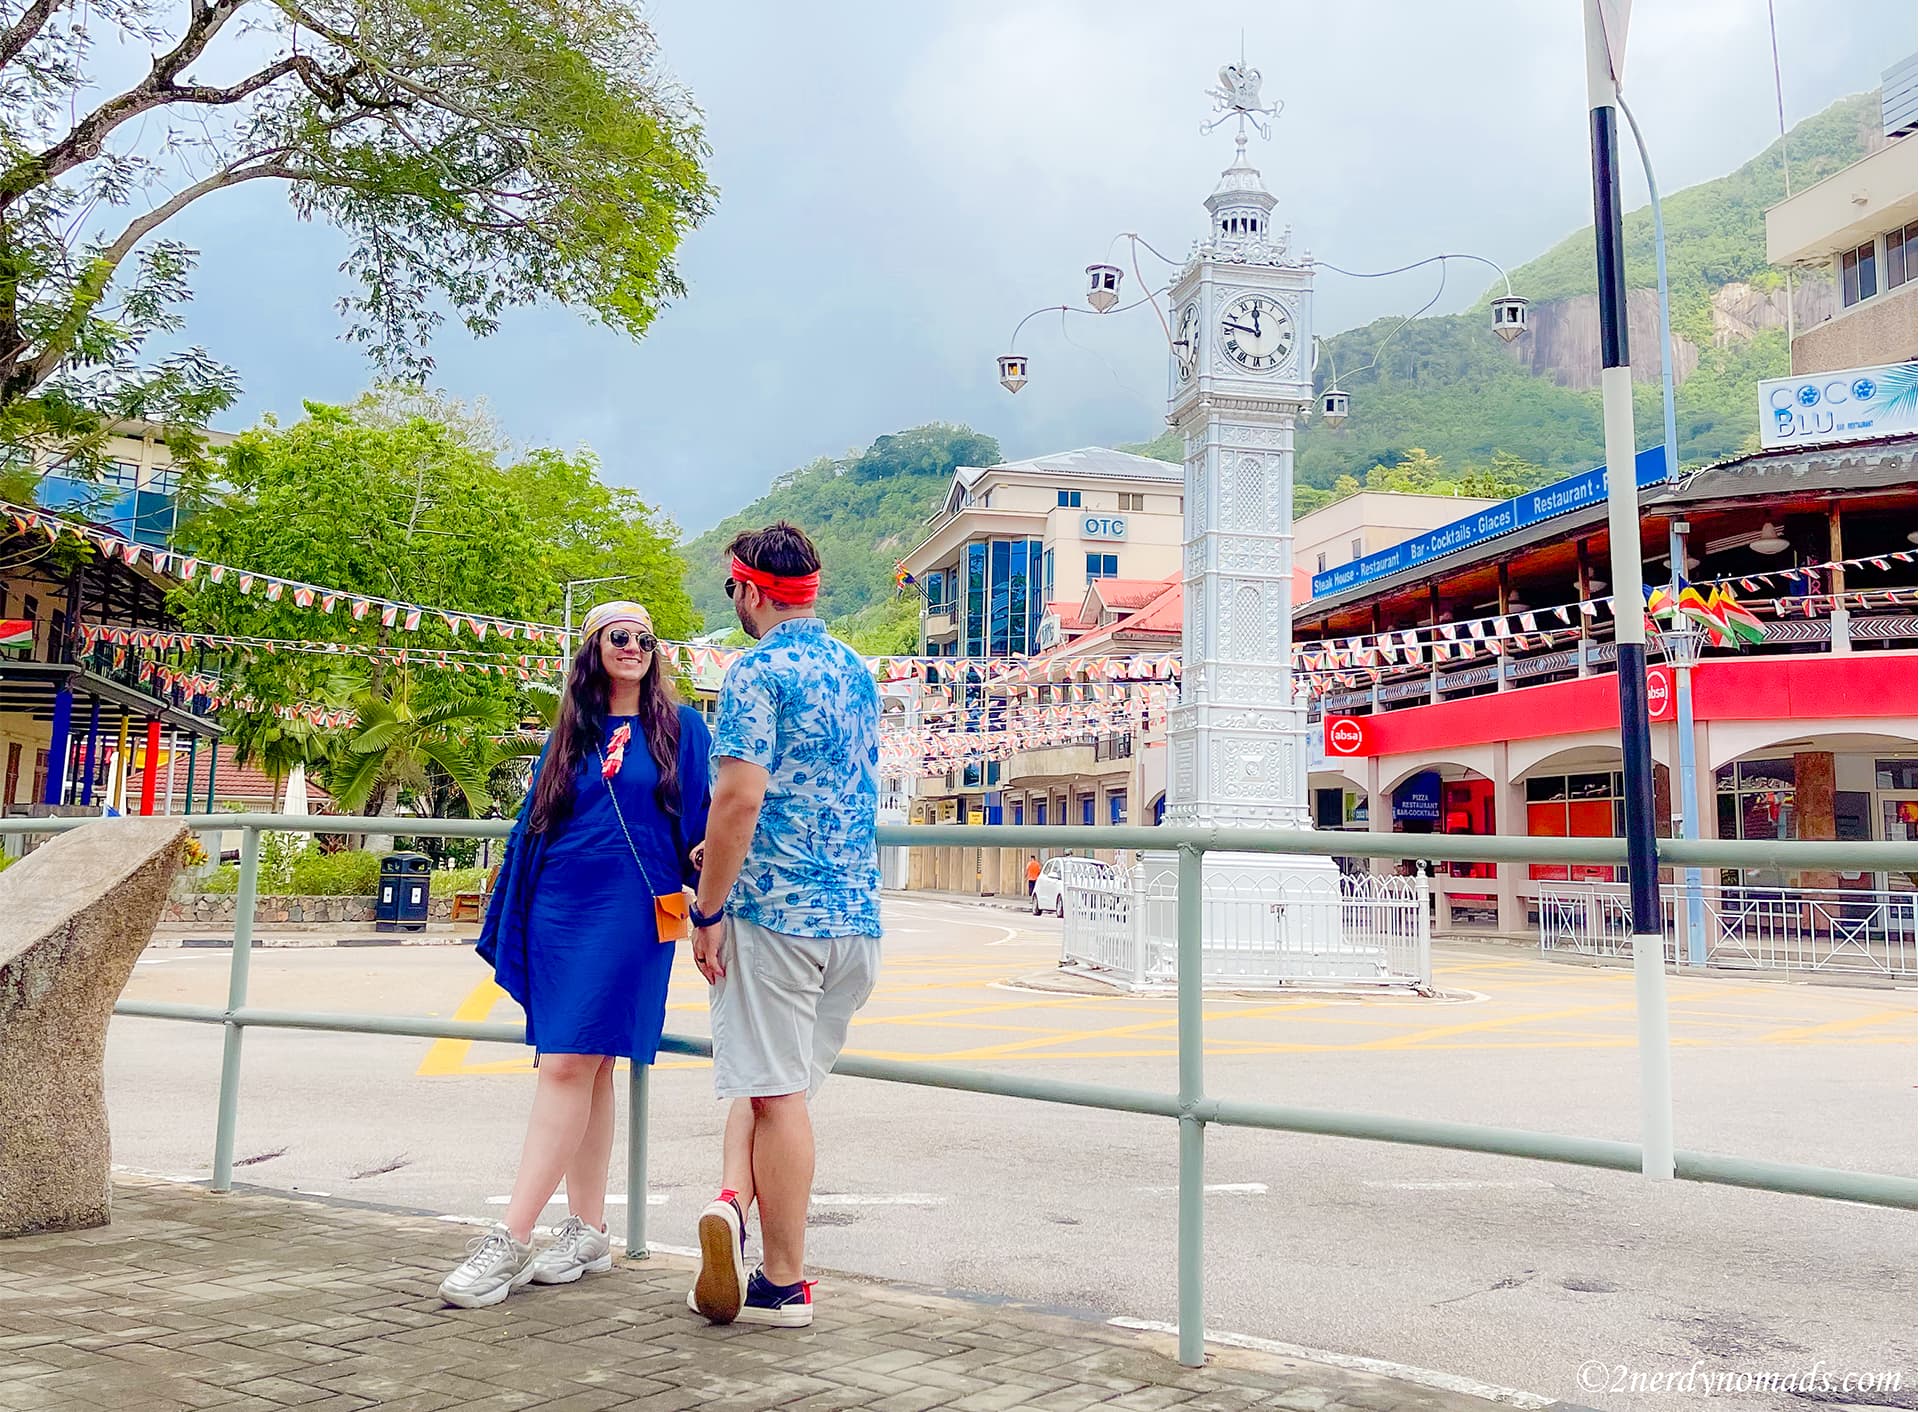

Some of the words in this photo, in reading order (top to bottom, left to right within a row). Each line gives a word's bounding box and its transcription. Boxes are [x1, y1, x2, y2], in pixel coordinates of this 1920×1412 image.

[1771, 378, 1876, 410] COCO
[1774, 408, 1834, 438] BLU
[1085, 518, 1124, 535] OTC
[1314, 575, 1333, 593] Steak
[1334, 568, 1354, 586] House
[1360, 552, 1400, 576] Restaurant
[1410, 542, 1425, 559] Bar
[1431, 524, 1471, 551] Cocktails
[1478, 511, 1511, 534] Glaces
[1533, 479, 1594, 514] Restaurant
[1334, 729, 1359, 741] absa
[1402, 801, 1438, 809] RESTAURANT
